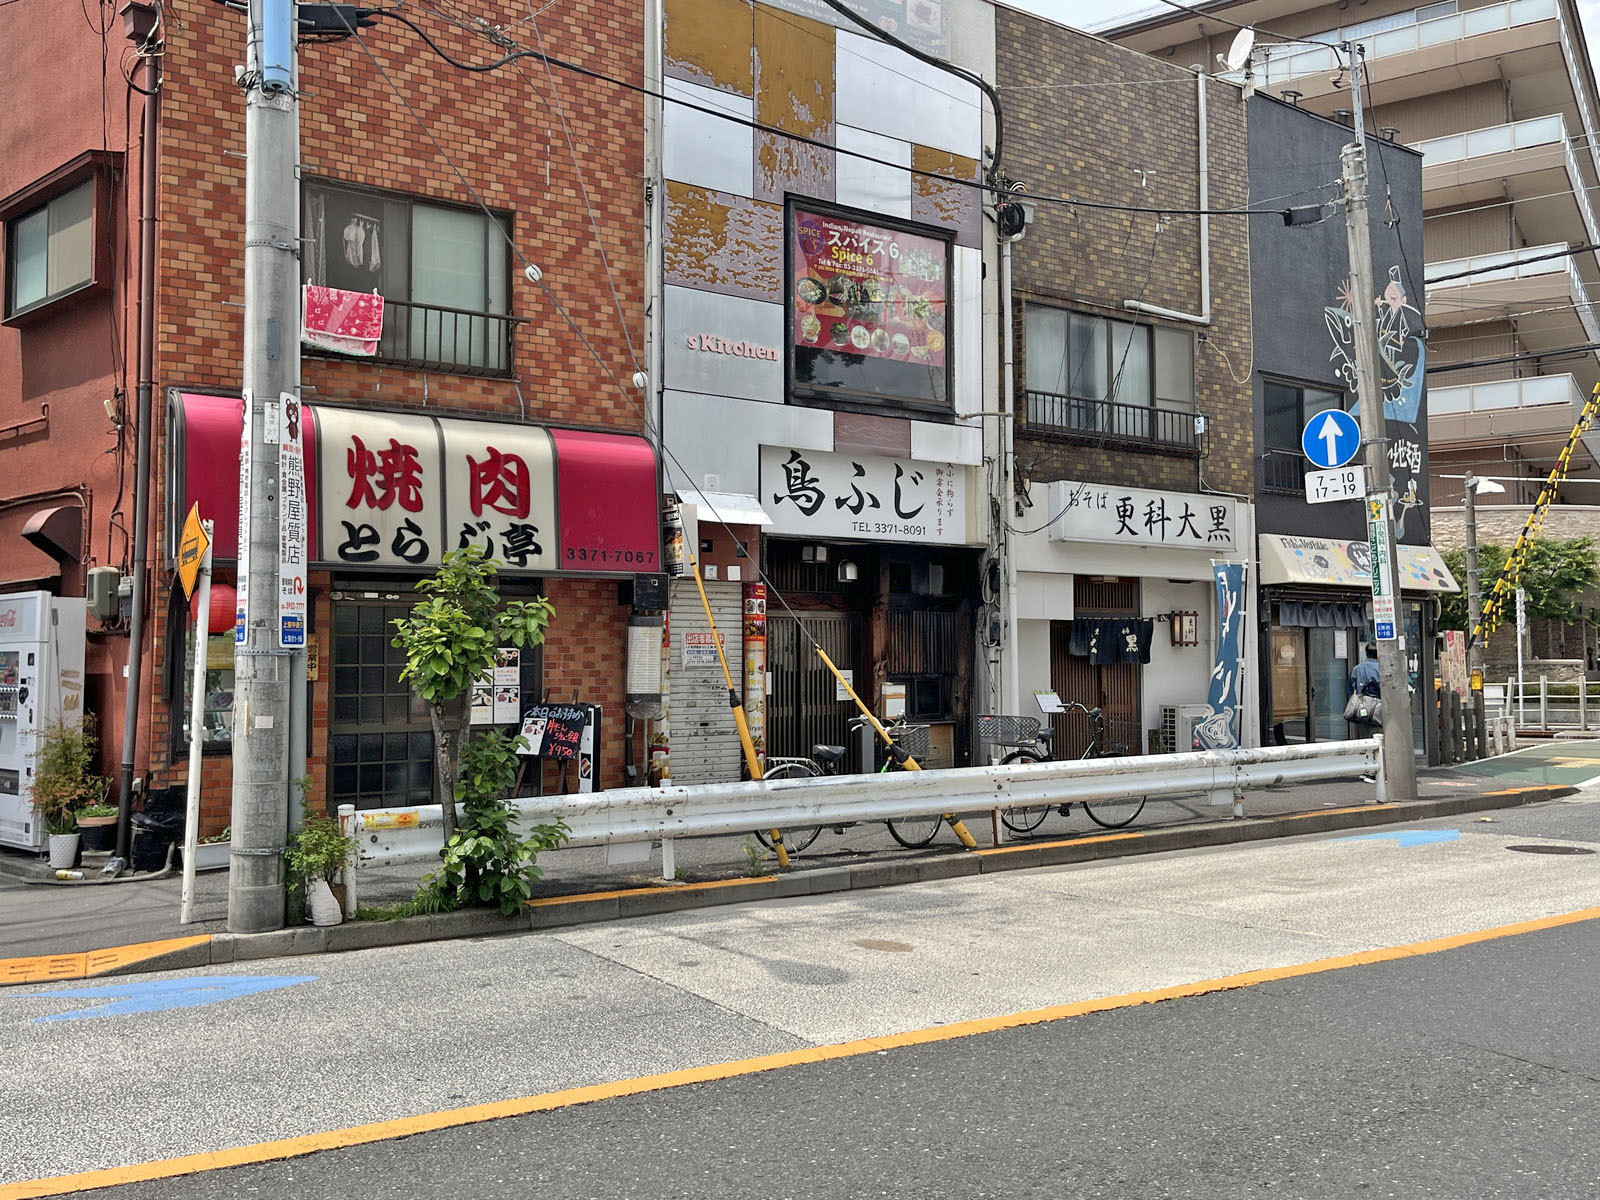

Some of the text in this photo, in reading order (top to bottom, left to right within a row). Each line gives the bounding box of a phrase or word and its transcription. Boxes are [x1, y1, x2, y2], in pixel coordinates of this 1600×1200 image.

[798, 226, 821, 238] SPICE
[862, 229, 893, 241] Restaurant
[827, 230, 899, 259] スパイス 6
[831, 246, 874, 265] Spice 6
[699, 334, 779, 362] Kitchen
[1387, 438, 1422, 474] 地酒
[346, 435, 531, 519] 焼肉
[773, 449, 925, 520] 鳥ふじ
[287, 454, 301, 564] 熊野屋質店
[1068, 489, 1110, 510] おそば
[852, 521, 926, 536] TEL 3371-8091
[1114, 496, 1231, 543] 更科大黒
[566, 547, 655, 563] 3371-7067
[281, 586, 293, 595] そば
[531, 705, 581, 721] 本日のおすすめ
[549, 743, 573, 756] ¥950
